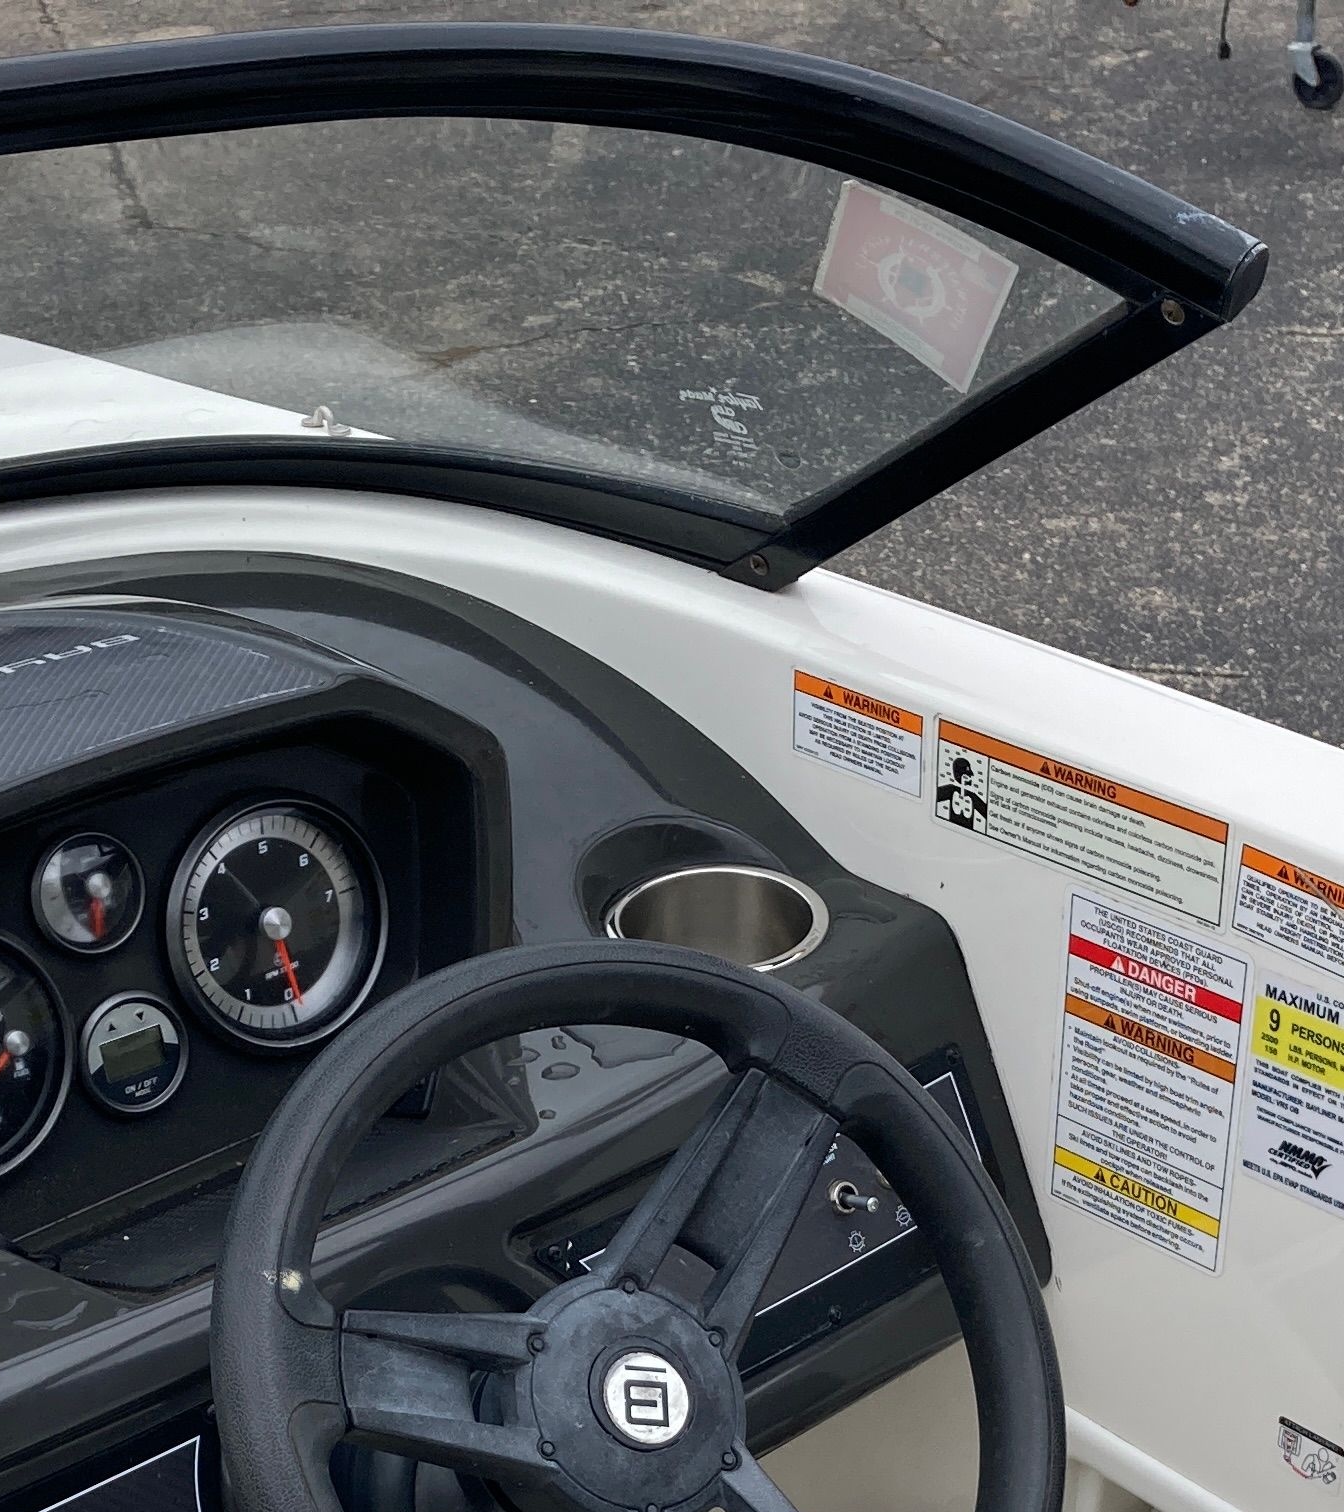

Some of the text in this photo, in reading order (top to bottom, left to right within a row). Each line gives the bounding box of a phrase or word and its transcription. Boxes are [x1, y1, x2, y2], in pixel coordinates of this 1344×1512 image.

[843, 690, 900, 724] WARNING
[1052, 764, 1117, 800] WARNING
[258, 841, 268, 854] 5
[299, 854, 309, 867] 6
[217, 863, 226, 874] 4
[325, 890, 333, 902] 7
[199, 907, 209, 921] 3
[1094, 906, 1222, 964] THE UNITED STATES COAST GUARD
[1125, 928, 1178, 956] RECOMMENDS
[1180, 950, 1199, 964] THAT
[1201, 959, 1215, 971] ALL
[210, 958, 219, 971] 2
[1080, 919, 1233, 988] OCCUPANTS WEAR APPROVED PERSONAL
[1102, 937, 1146, 961] FLOATATION
[1148, 955, 1180, 975] DEVICES
[244, 989, 251, 1000] 1
[1127, 960, 1196, 1002] DANGER
[1143, 986, 1157, 998] MAY
[1158, 992, 1183, 1009] CAUSE
[1184, 1003, 1217, 1024] SERIOUS
[1265, 984, 1339, 1024] MAXIMUM
[1316, 993, 1330, 1004] U.S.
[1268, 1007, 1280, 1033] 9
[1120, 1018, 1194, 1063] WARNING
[1288, 1043, 1303, 1055] LBS.
[1305, 1050, 1338, 1071] PERSONS,
[1109, 1173, 1177, 1217] CAUTION
